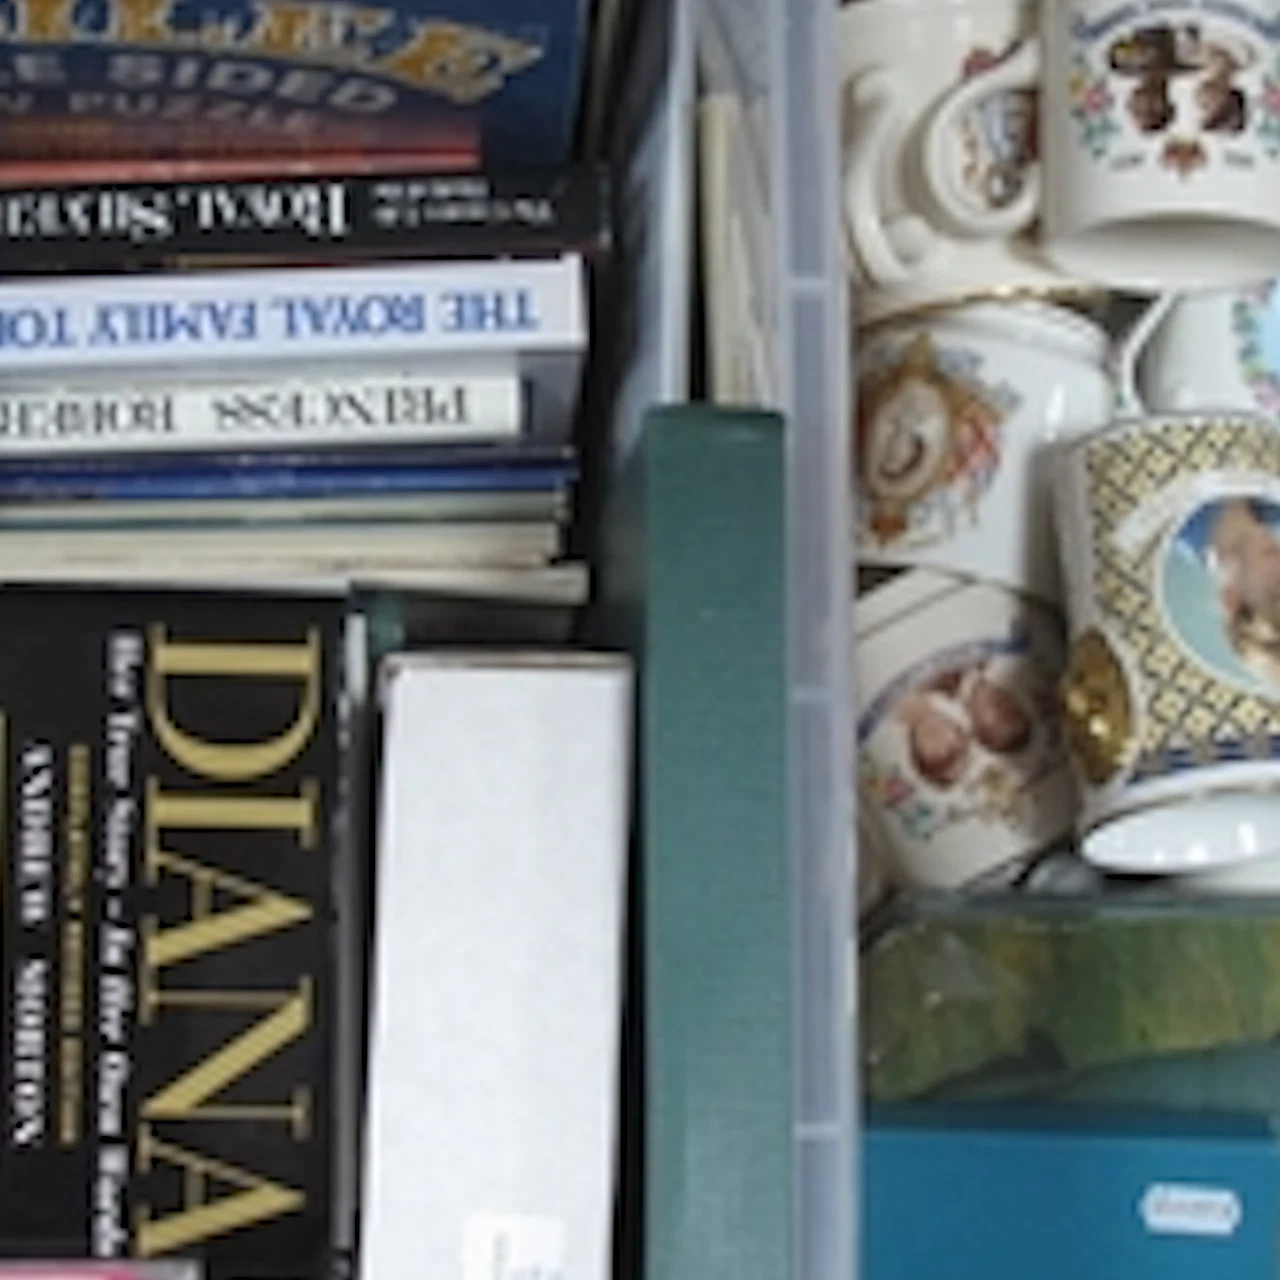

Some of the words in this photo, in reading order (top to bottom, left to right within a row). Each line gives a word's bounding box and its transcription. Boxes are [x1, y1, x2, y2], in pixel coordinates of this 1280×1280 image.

[107, 50, 400, 116] SIDED
[175, 183, 347, 241] ROYAL
[86, 296, 259, 347] FAMILY
[271, 292, 426, 339] ROYAL
[440, 287, 539, 334] THE
[210, 384, 470, 434] PRINCESS
[110, 631, 143, 699] Her
[107, 710, 141, 790] True
[18, 742, 55, 927] ANDREW
[93, 796, 138, 889] Story
[132, 621, 322, 1260] DIANA
[12, 955, 48, 1149] MORTON
[95, 1050, 131, 1135] Own
[92, 1142, 130, 1259] Words
